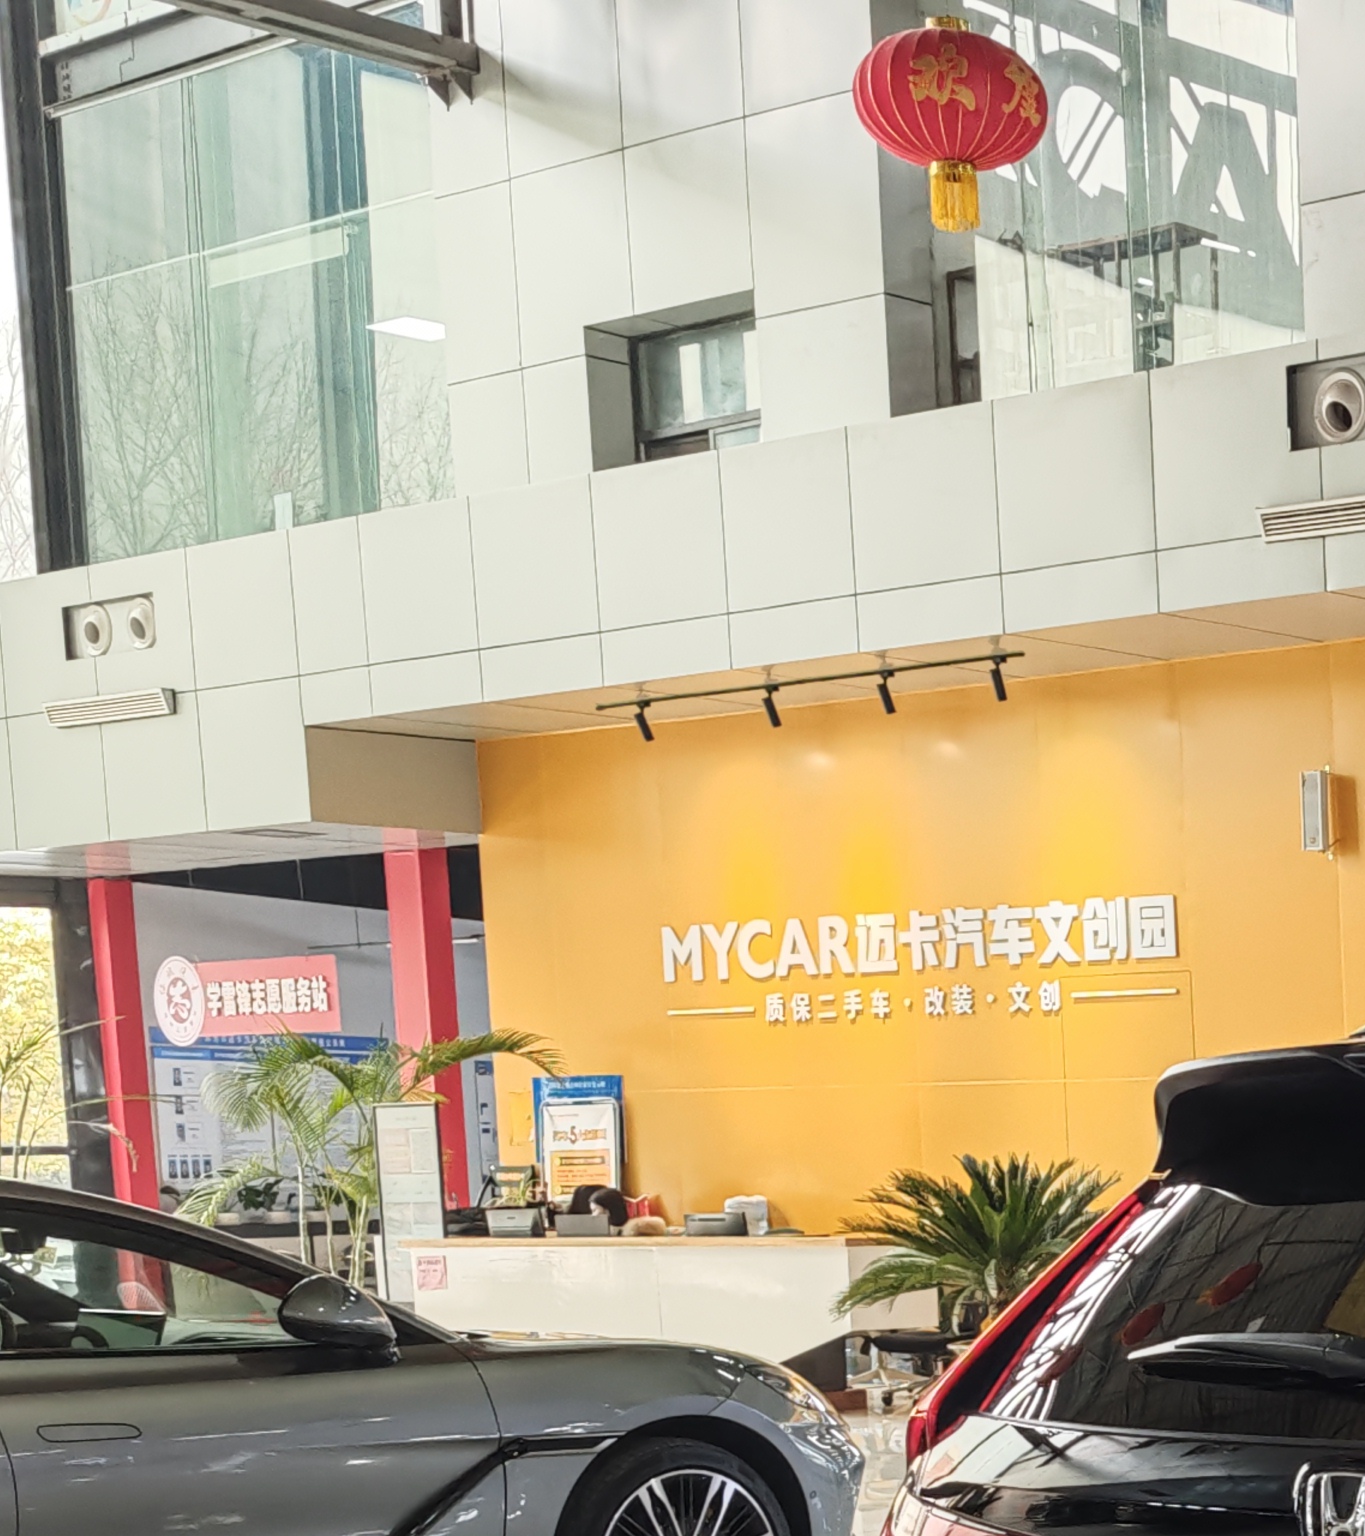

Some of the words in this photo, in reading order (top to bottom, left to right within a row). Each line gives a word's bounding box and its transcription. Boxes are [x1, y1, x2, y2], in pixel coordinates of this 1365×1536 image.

[660, 894, 1178, 984] MYCAR迈卡汽车文创园
[206, 974, 329, 1017] 学雷锋志愿服务站
